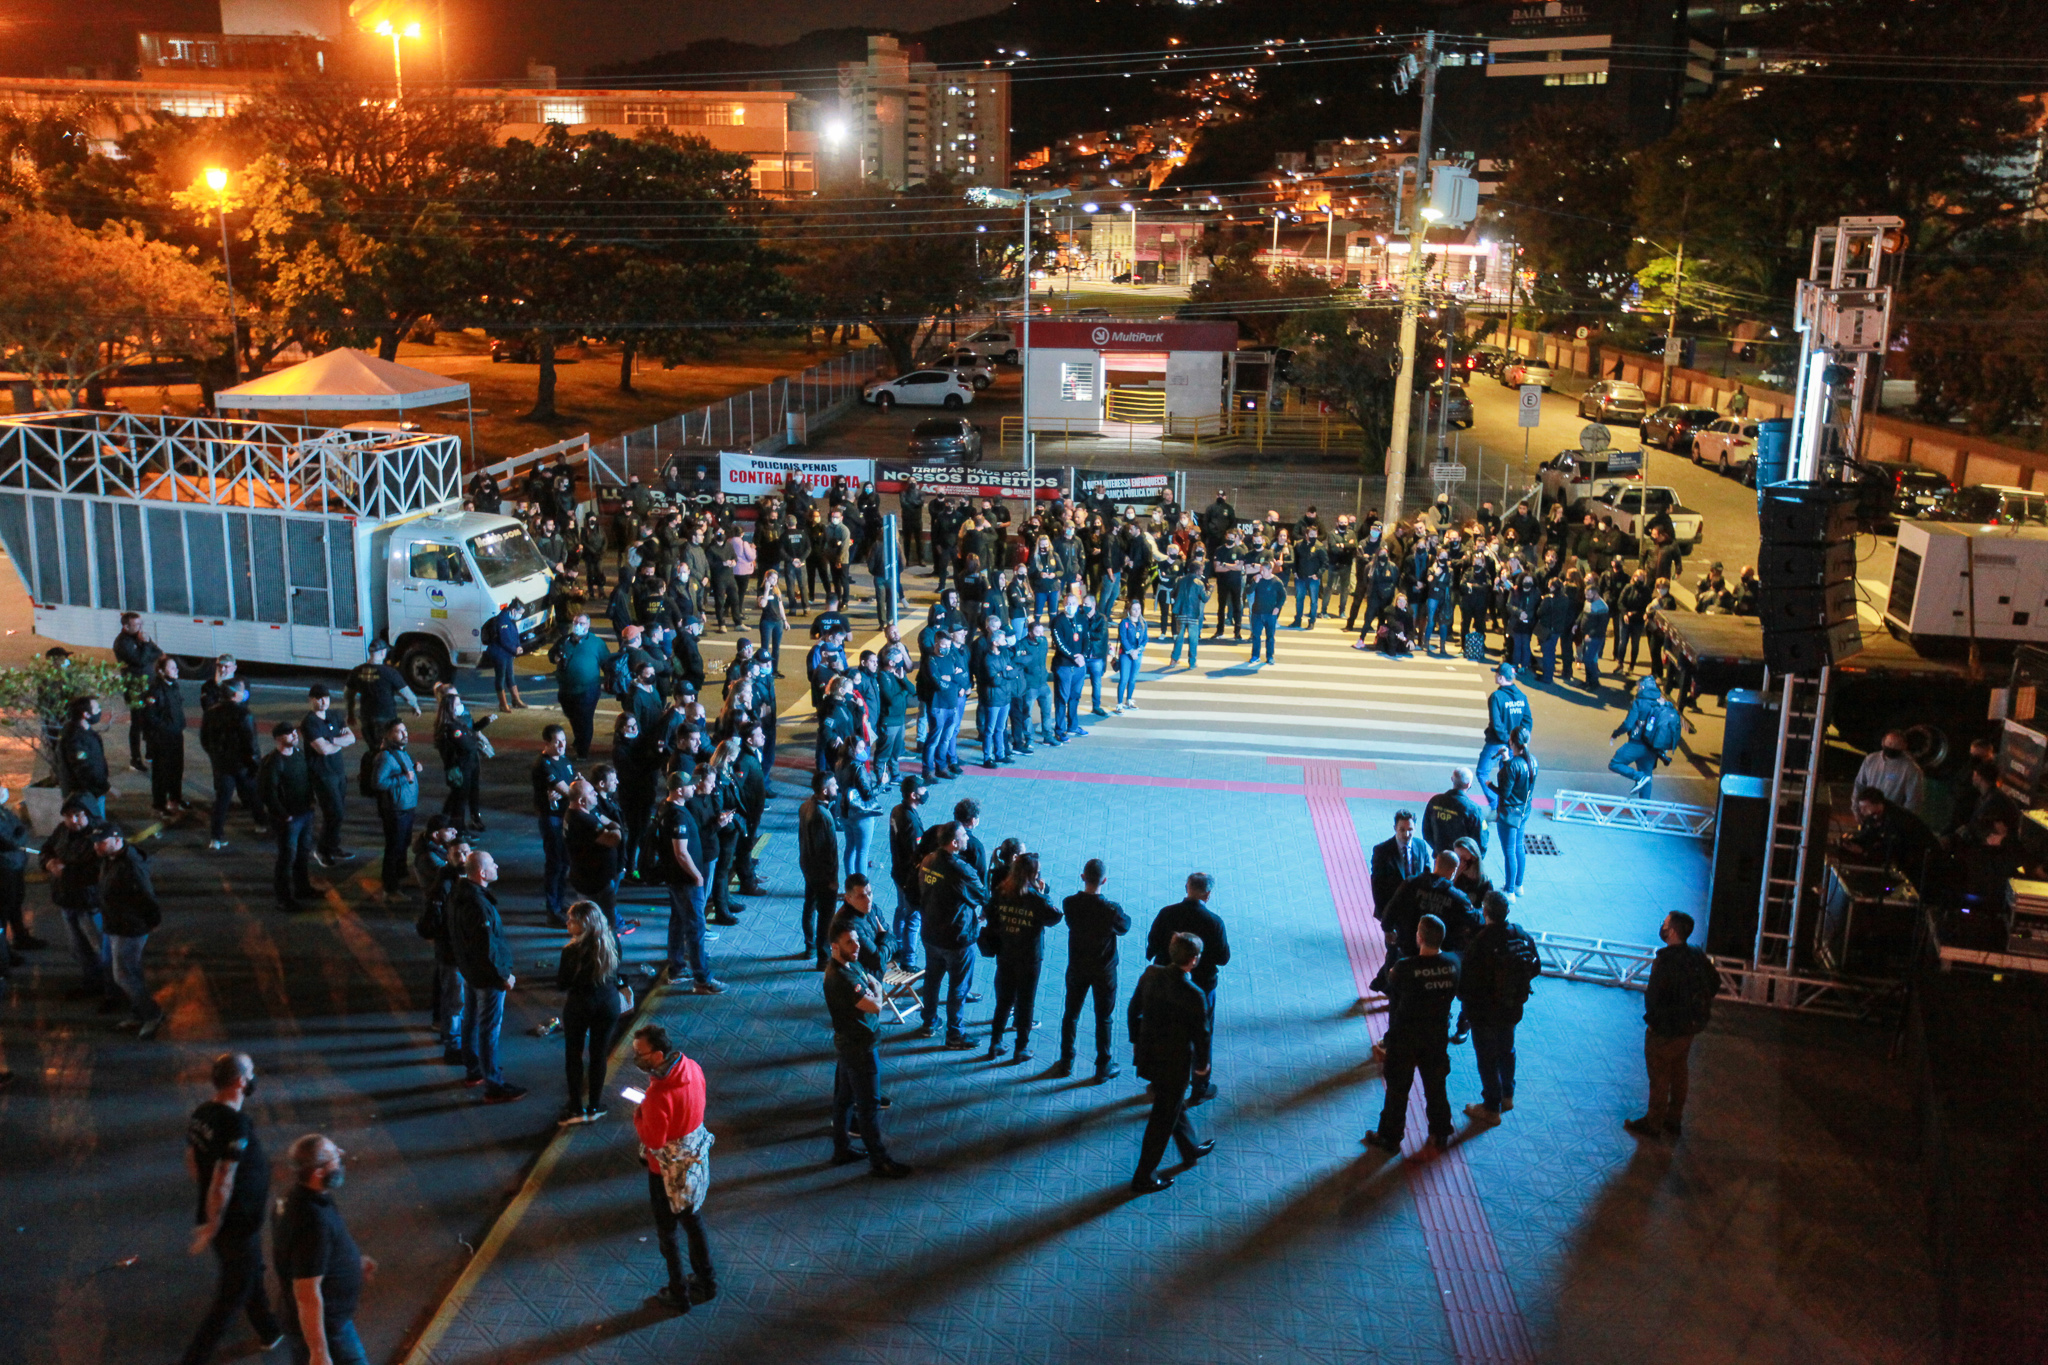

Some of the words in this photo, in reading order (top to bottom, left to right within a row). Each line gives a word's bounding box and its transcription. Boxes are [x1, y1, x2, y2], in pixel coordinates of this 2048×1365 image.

[751, 460, 800, 471] POLICIAIS
[802, 463, 838, 473] PENAIS
[729, 469, 783, 486] CONTRA
[883, 471, 962, 484] NOSSOS
[966, 473, 1058, 487] DIREITOS
[1437, 811, 1452, 821] IGP
[924, 873, 937, 885] IGP
